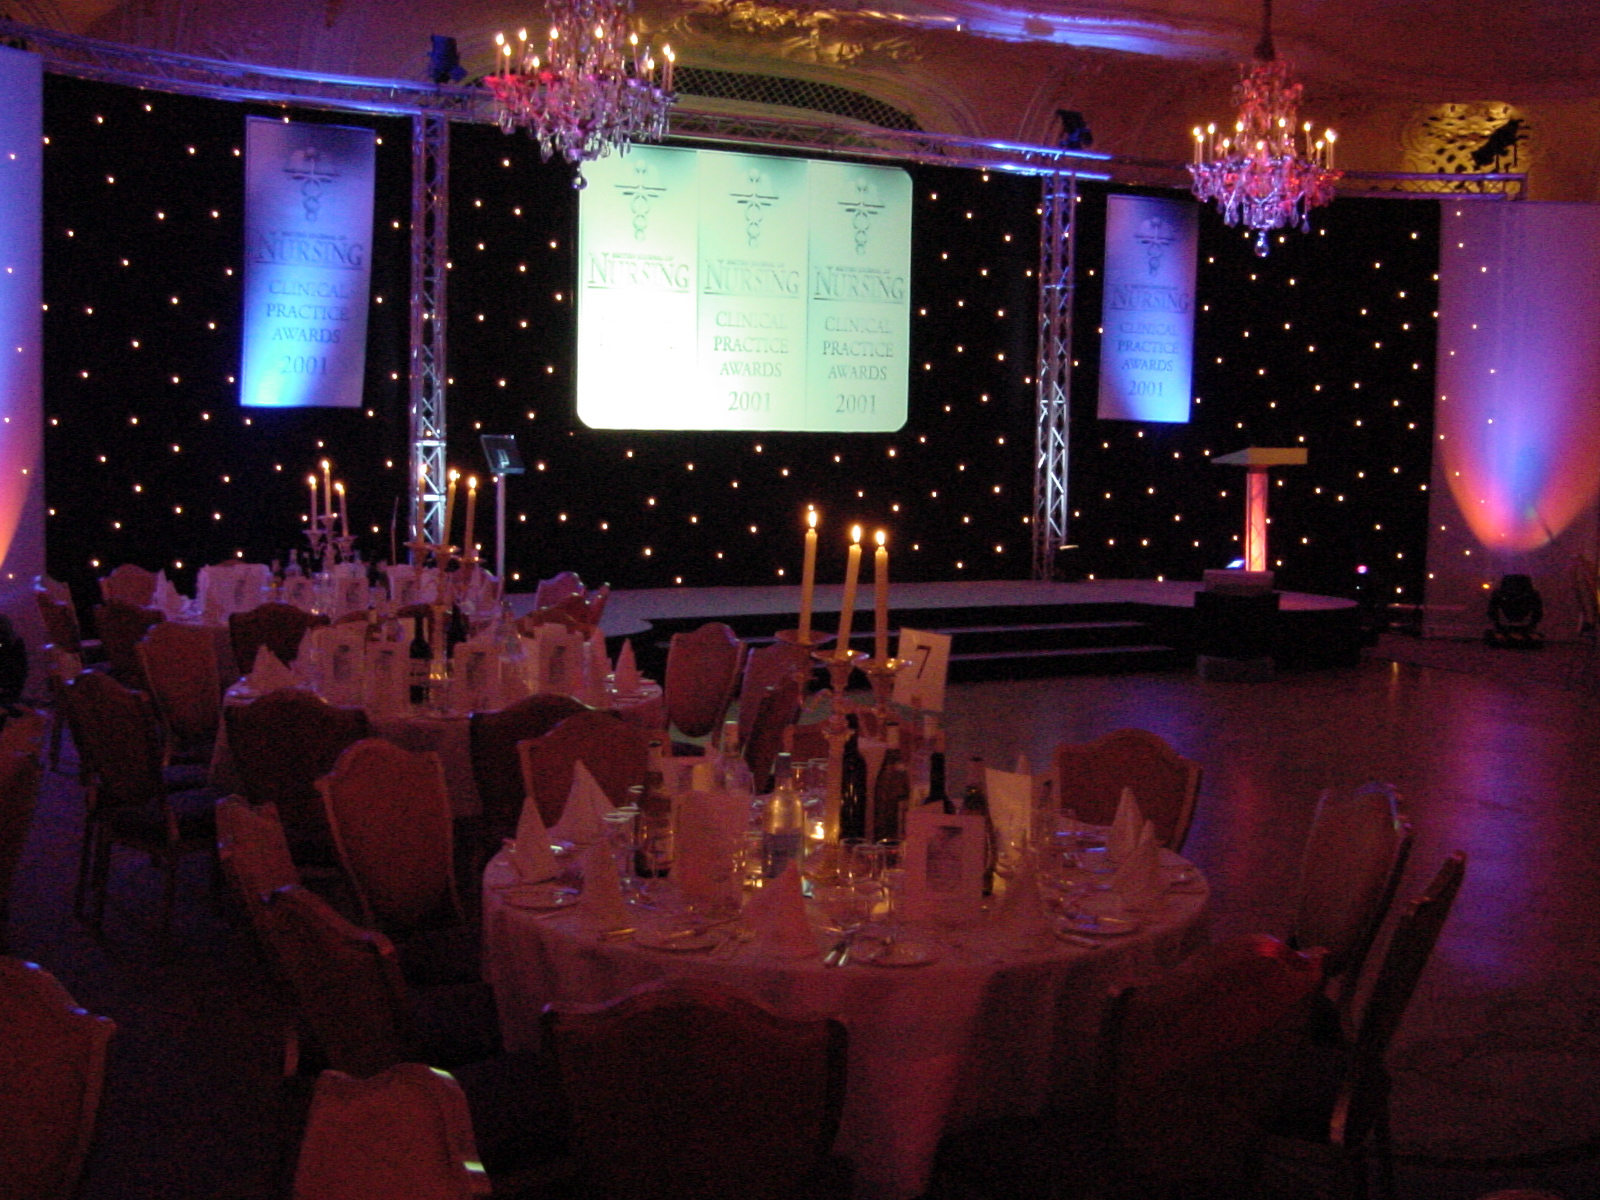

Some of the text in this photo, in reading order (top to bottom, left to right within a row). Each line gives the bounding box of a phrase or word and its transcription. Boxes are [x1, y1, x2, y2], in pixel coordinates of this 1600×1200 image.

[258, 234, 363, 266] NURSING
[705, 260, 799, 294] NURSING
[814, 266, 904, 299] NURSING
[1111, 286, 1189, 311] NURSING
[266, 303, 349, 321] PRACTICE
[272, 327, 341, 343] AWARDS
[714, 336, 789, 353] PRACTICE
[823, 341, 894, 357] PRACTICE
[1117, 340, 1180, 354] PRACTICE
[281, 355, 328, 375] 2001
[720, 361, 782, 377] AWARDS
[828, 365, 887, 380] AWARDS
[1121, 358, 1174, 372] AWARDS
[1128, 380, 1163, 396] 2001
[728, 391, 773, 411] 2001
[836, 394, 877, 414] 2001
[916, 645, 932, 679] 7
